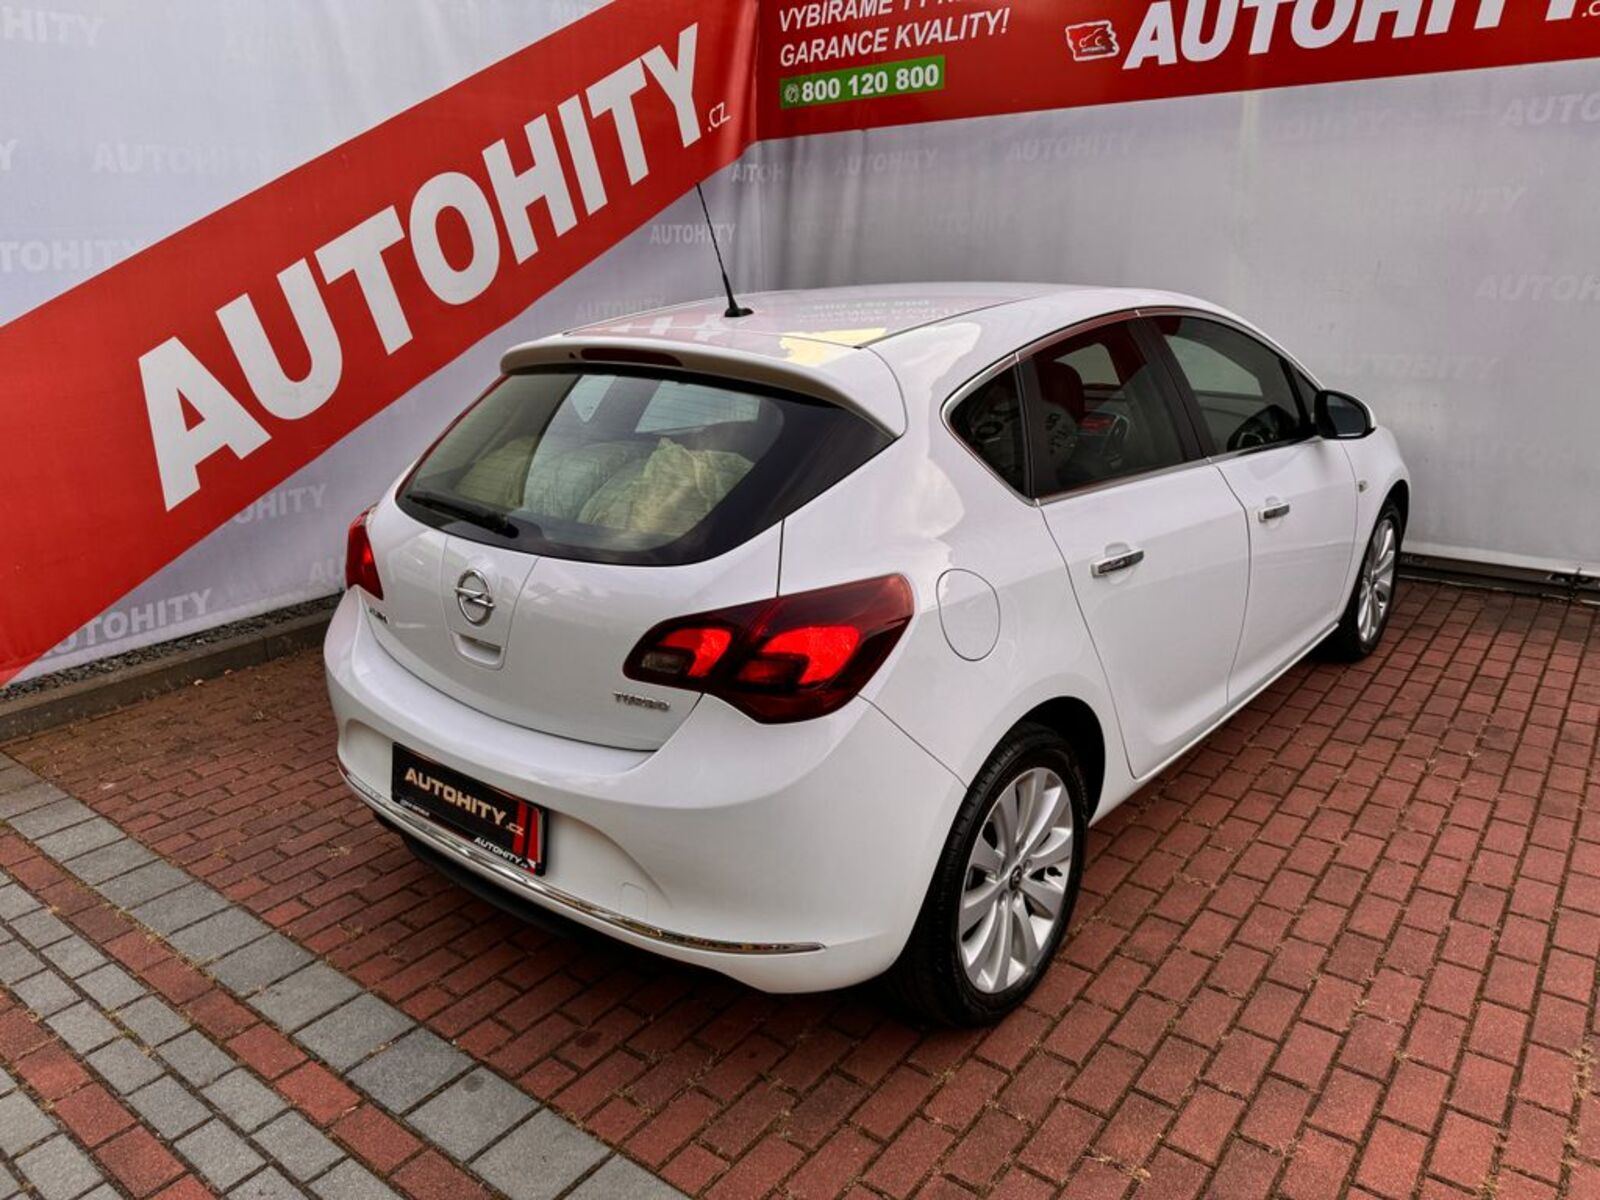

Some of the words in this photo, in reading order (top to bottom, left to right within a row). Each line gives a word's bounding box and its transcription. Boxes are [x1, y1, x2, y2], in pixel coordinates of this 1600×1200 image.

[780, 28, 889, 67] GARANCE
[895, 7, 1010, 50] KVALITY!
[801, 77, 841, 102] 800
[848, 71, 888, 96] 120
[895, 64, 939, 90] 800
[650, 223, 736, 245] AUTOHTY
